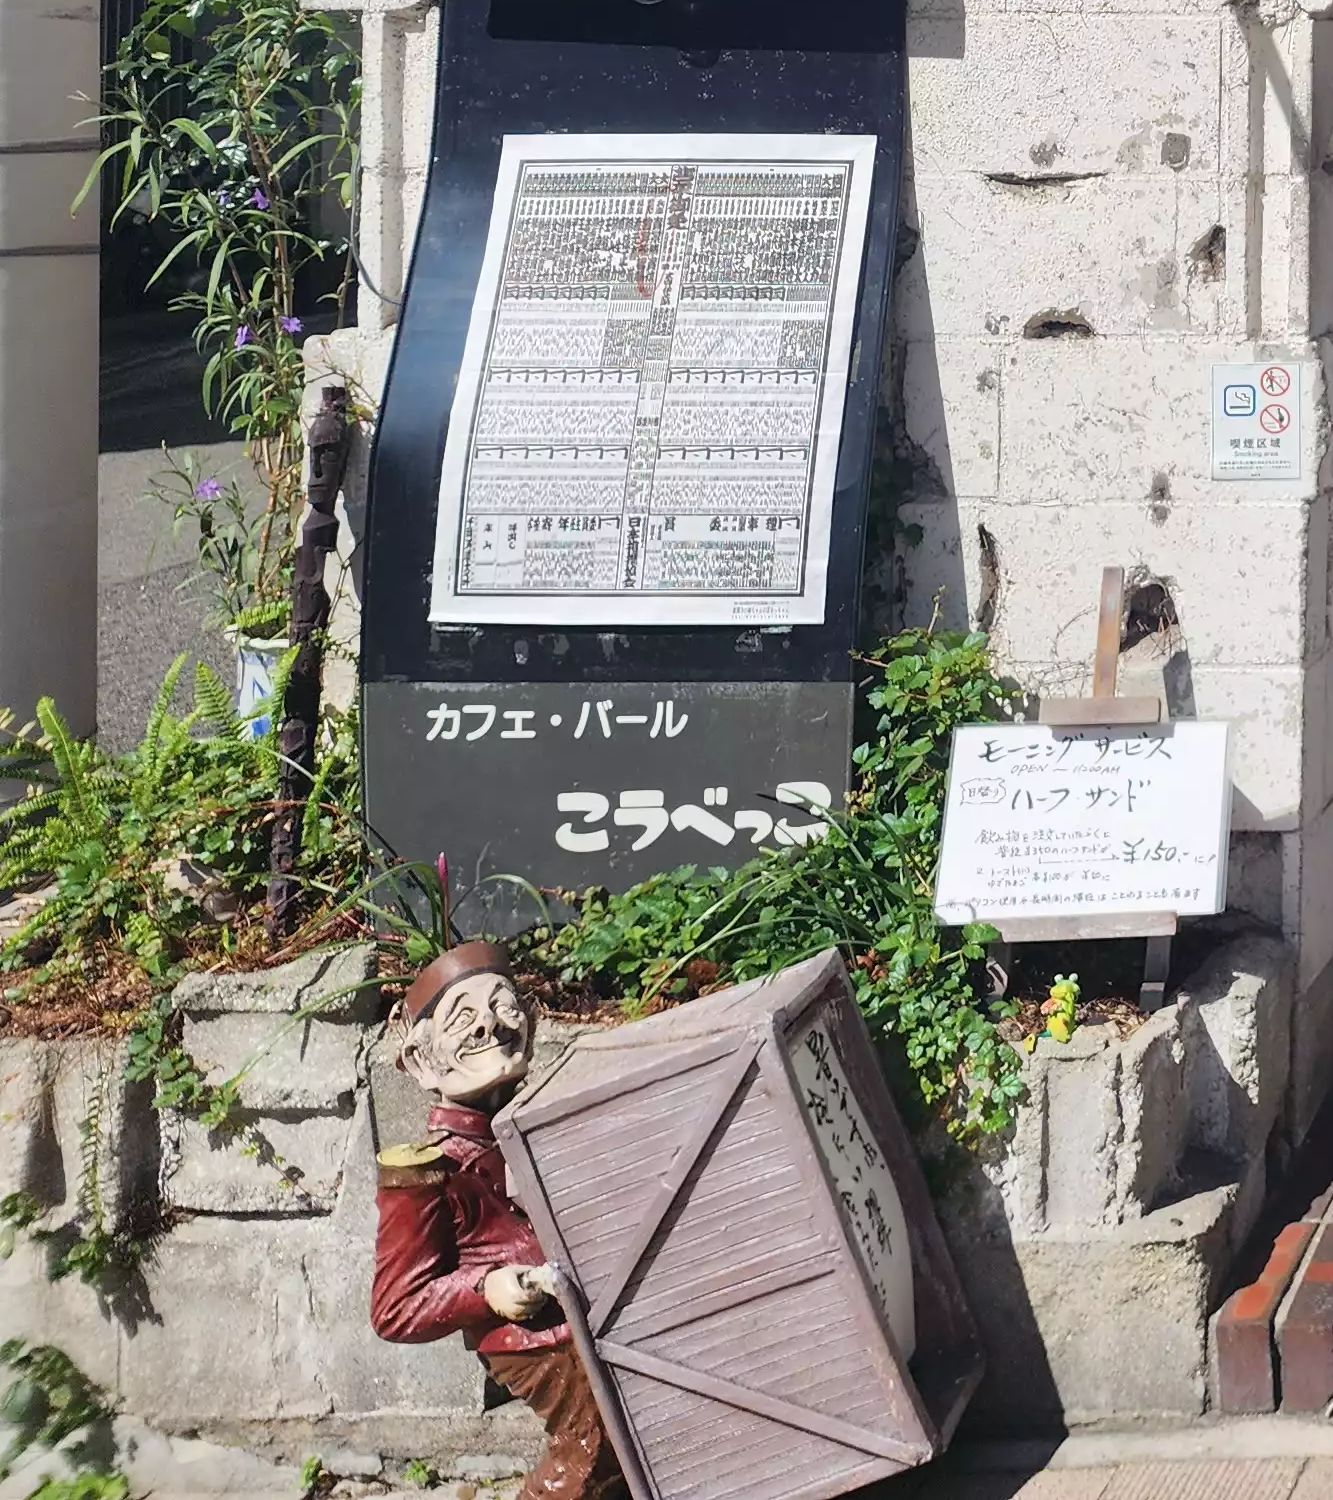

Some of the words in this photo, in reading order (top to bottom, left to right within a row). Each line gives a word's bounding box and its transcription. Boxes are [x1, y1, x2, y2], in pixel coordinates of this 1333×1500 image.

[1230, 437, 1281, 449] 喫煙区域
[425, 699, 689, 742] カフェ・バール
[978, 732, 1085, 763] モーニング
[1095, 730, 1172, 763] サービス
[1010, 763, 1049, 777] OPEN
